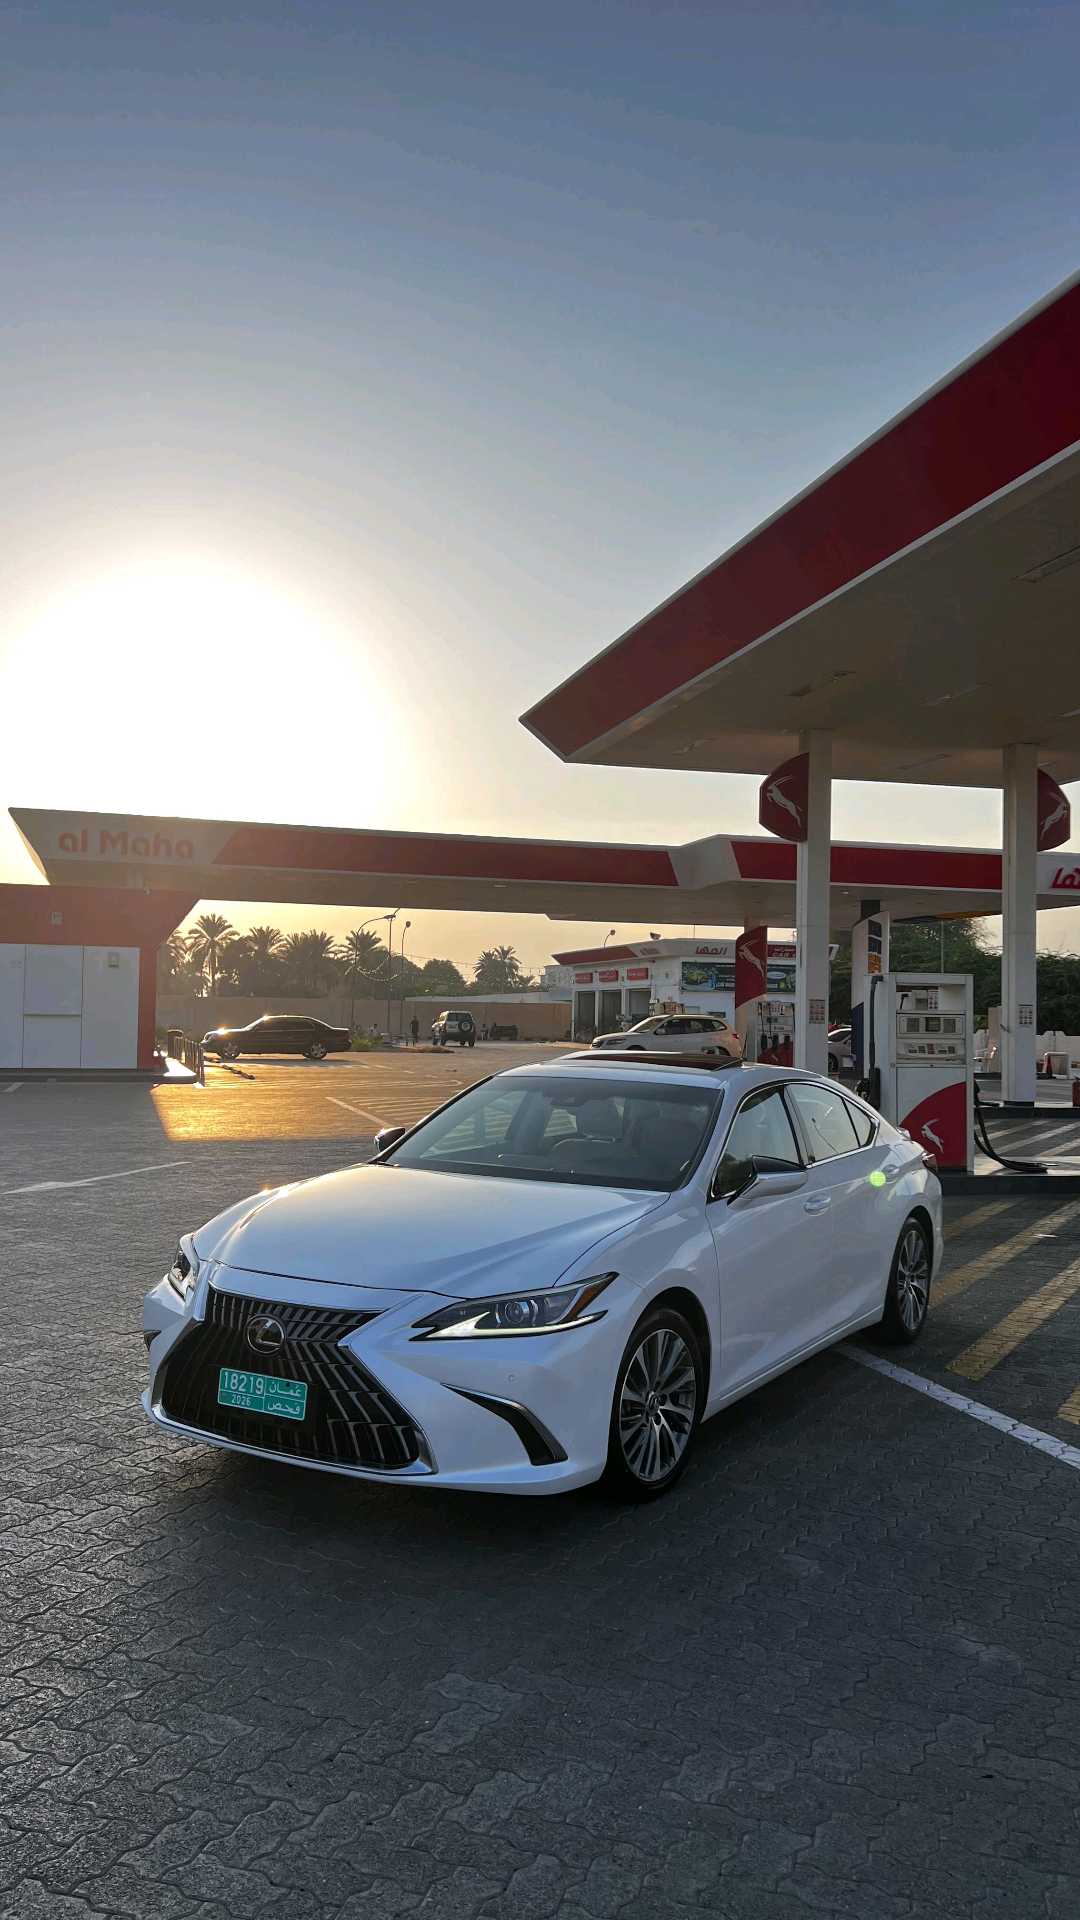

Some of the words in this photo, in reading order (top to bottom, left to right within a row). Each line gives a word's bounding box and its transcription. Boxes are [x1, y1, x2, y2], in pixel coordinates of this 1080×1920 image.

[59, 829, 88, 852] al
[101, 830, 193, 858] Maha
[695, 945, 728, 955] المها
[223, 1371, 265, 1395] 18219
[231, 1394, 252, 1406] 2026
[267, 1400, 301, 1415] فحص
